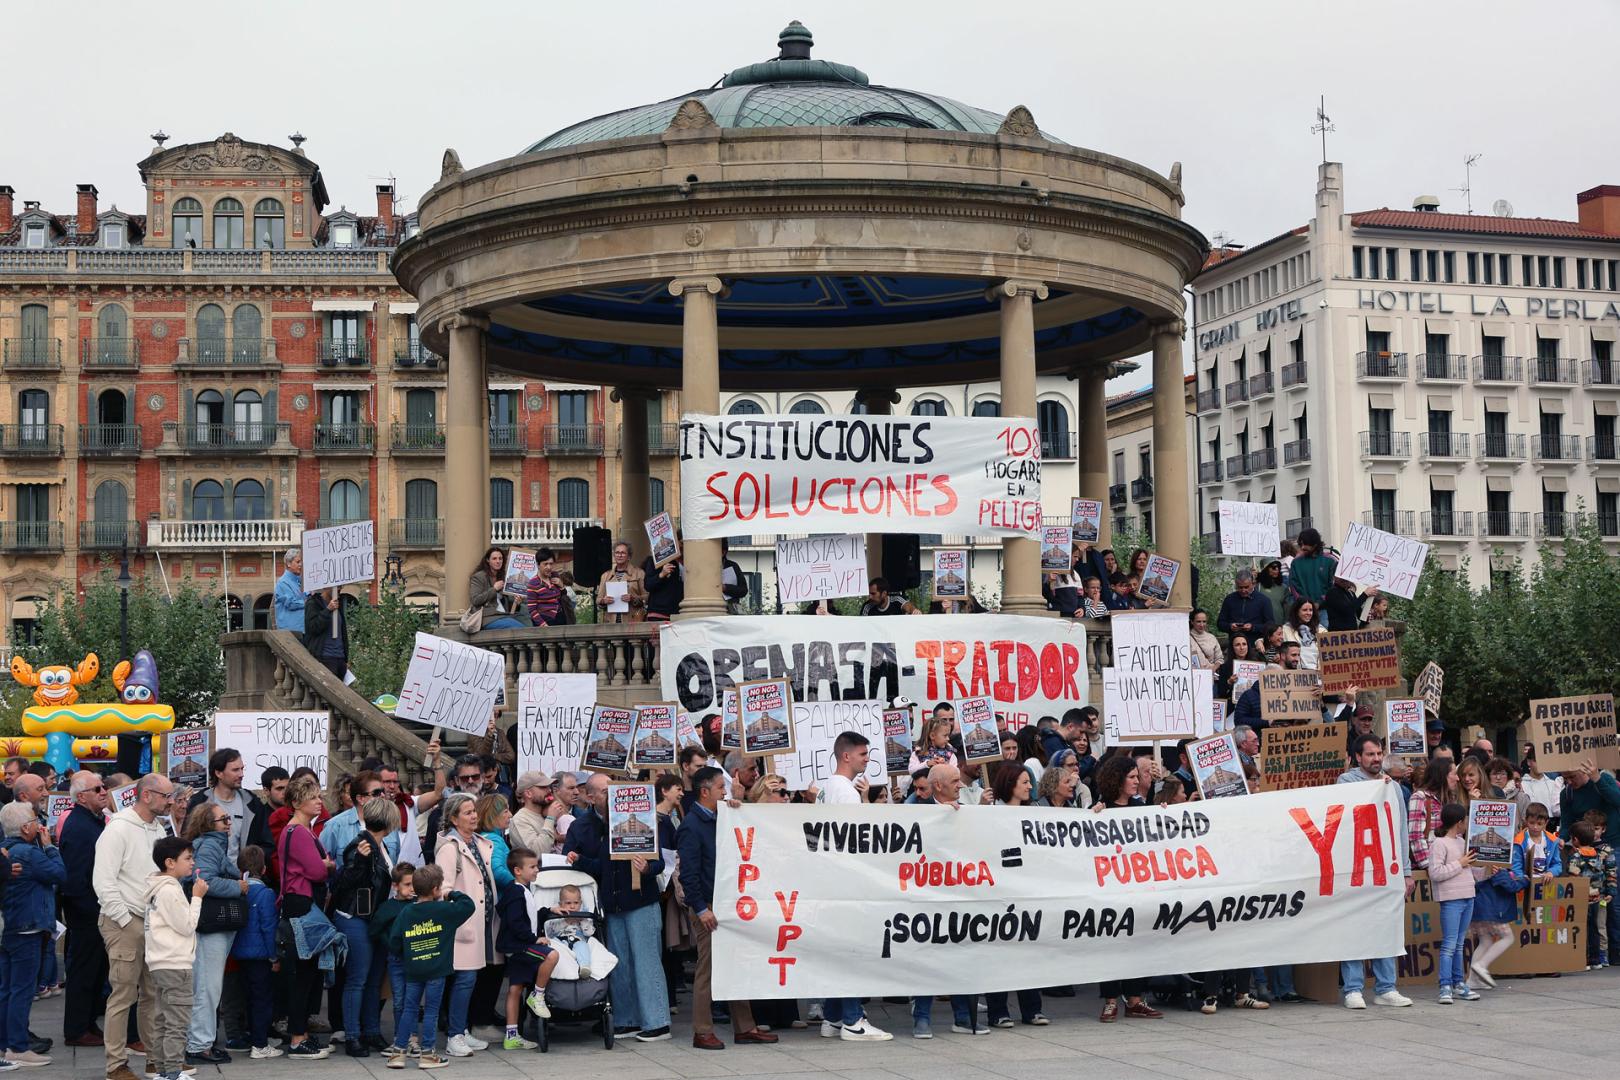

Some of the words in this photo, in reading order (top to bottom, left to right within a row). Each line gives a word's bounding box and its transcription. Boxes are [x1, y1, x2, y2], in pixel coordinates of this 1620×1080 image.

[1359, 288, 1454, 313] HOTEL
[1471, 294, 1511, 316] LA
[1527, 296, 1620, 320] PERLA
[1200, 320, 1240, 351] GRAN
[1257, 298, 1308, 331] HOTEL
[680, 419, 934, 464] INSTITUCIONES
[997, 426, 1040, 460] 108
[706, 471, 958, 521] SOLUCIONES
[1008, 482, 1025, 496] EN
[322, 524, 373, 555] PROBLEMAS
[778, 538, 845, 564] MARISTAS
[1347, 521, 1415, 561] MARISTAS
[323, 552, 374, 584] SOLUCIONES
[1340, 556, 1370, 580] VPO
[1389, 571, 1417, 595] VPT
[780, 575, 812, 599] VPO
[834, 568, 865, 593] VPT
[432, 640, 503, 693] BLOQUEO
[1118, 645, 1190, 672] FAMILIAS
[522, 676, 558, 706] 108
[761, 685, 776, 694] NOS
[1119, 676, 1150, 701] UNA
[1153, 675, 1190, 701] MISMA
[1263, 673, 1290, 689] MENOS
[1284, 690, 1291, 700] Y
[418, 682, 490, 732] LADRILLO
[525, 707, 592, 730] FAMILIAS
[748, 702, 761, 711] 108
[795, 703, 881, 739] PALABRAS
[1125, 702, 1190, 732] LUCHA
[1536, 700, 1613, 719] ABAURREA
[257, 718, 329, 744] PROBLEMAS
[521, 731, 555, 756] UNA
[1198, 744, 1208, 753] NO
[1209, 739, 1223, 749] NOS
[1268, 733, 1282, 743] EL
[1284, 728, 1318, 741] MUNDO
[1323, 726, 1337, 737] AL
[1543, 741, 1553, 754] A
[1555, 734, 1581, 754] 108
[1200, 758, 1212, 767] 108
[1265, 757, 1281, 767] LOS
[1287, 771, 1320, 781] RIESGO
[124, 790, 134, 799] NO
[616, 803, 628, 812] 108
[803, 821, 923, 854] VIVIENDA
[1021, 810, 1210, 847] RESPONSABILIDAD
[1288, 801, 1399, 896] YA!
[734, 827, 760, 921] VPO
[898, 854, 994, 890] PÚBLICA
[1094, 844, 1218, 887] PÚBLICA
[405, 924, 442, 938] BROTHER
[768, 891, 802, 986] VPT
[881, 904, 1042, 958] ¡SOLUCIÓN
[1062, 907, 1134, 939] PARA
[1152, 890, 1305, 935] MARISTAS
[1412, 912, 1431, 936] DE
